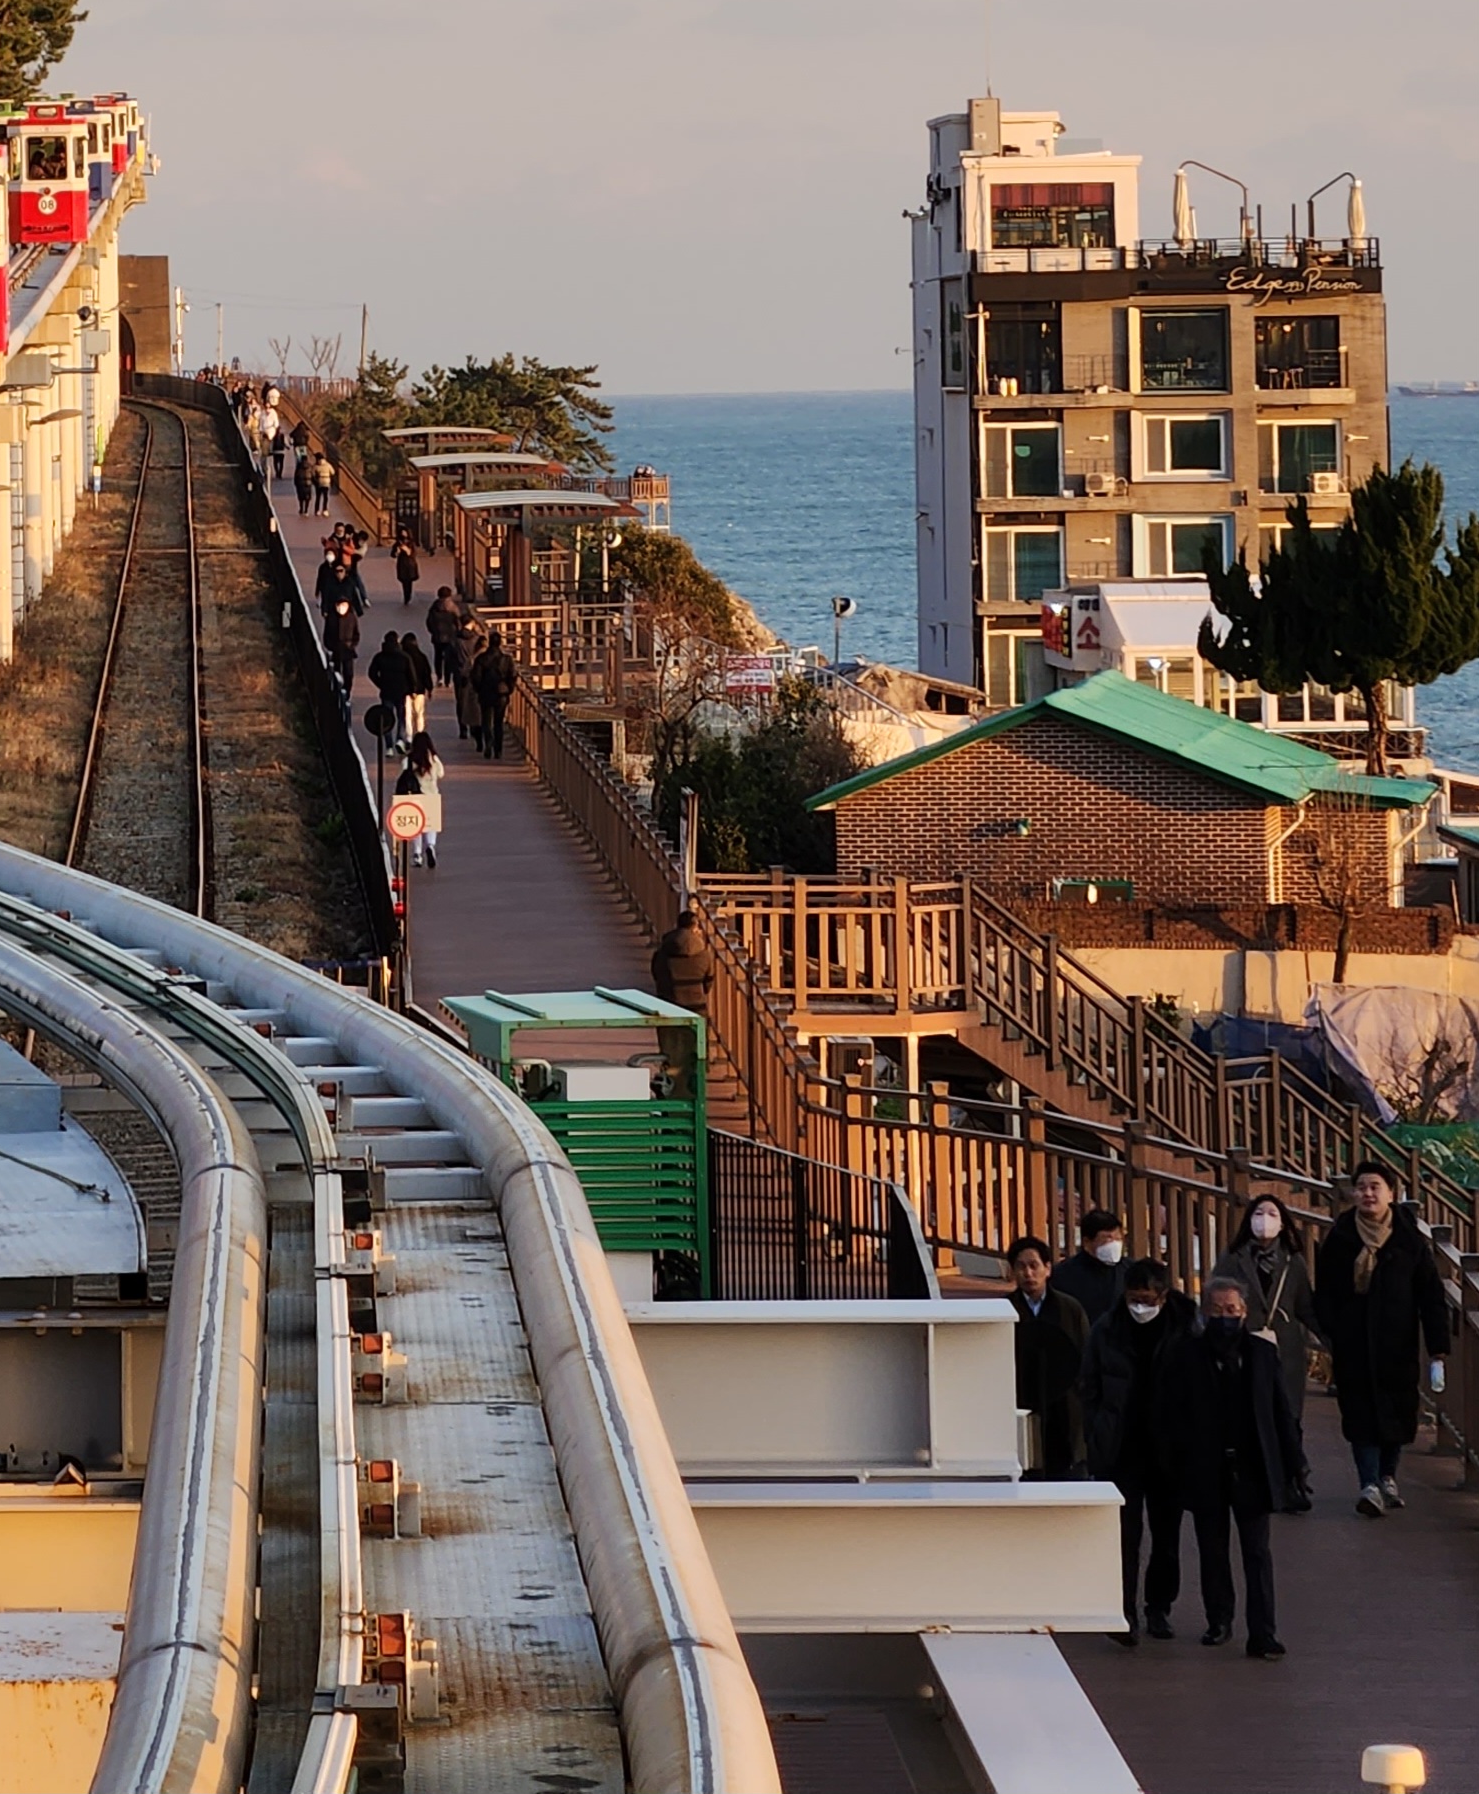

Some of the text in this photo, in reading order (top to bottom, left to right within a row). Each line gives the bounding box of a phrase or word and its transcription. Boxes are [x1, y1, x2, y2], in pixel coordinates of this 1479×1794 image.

[41, 200, 54, 210] 08
[1302, 267, 1363, 293] Pension
[396, 815, 419, 828] 정지
